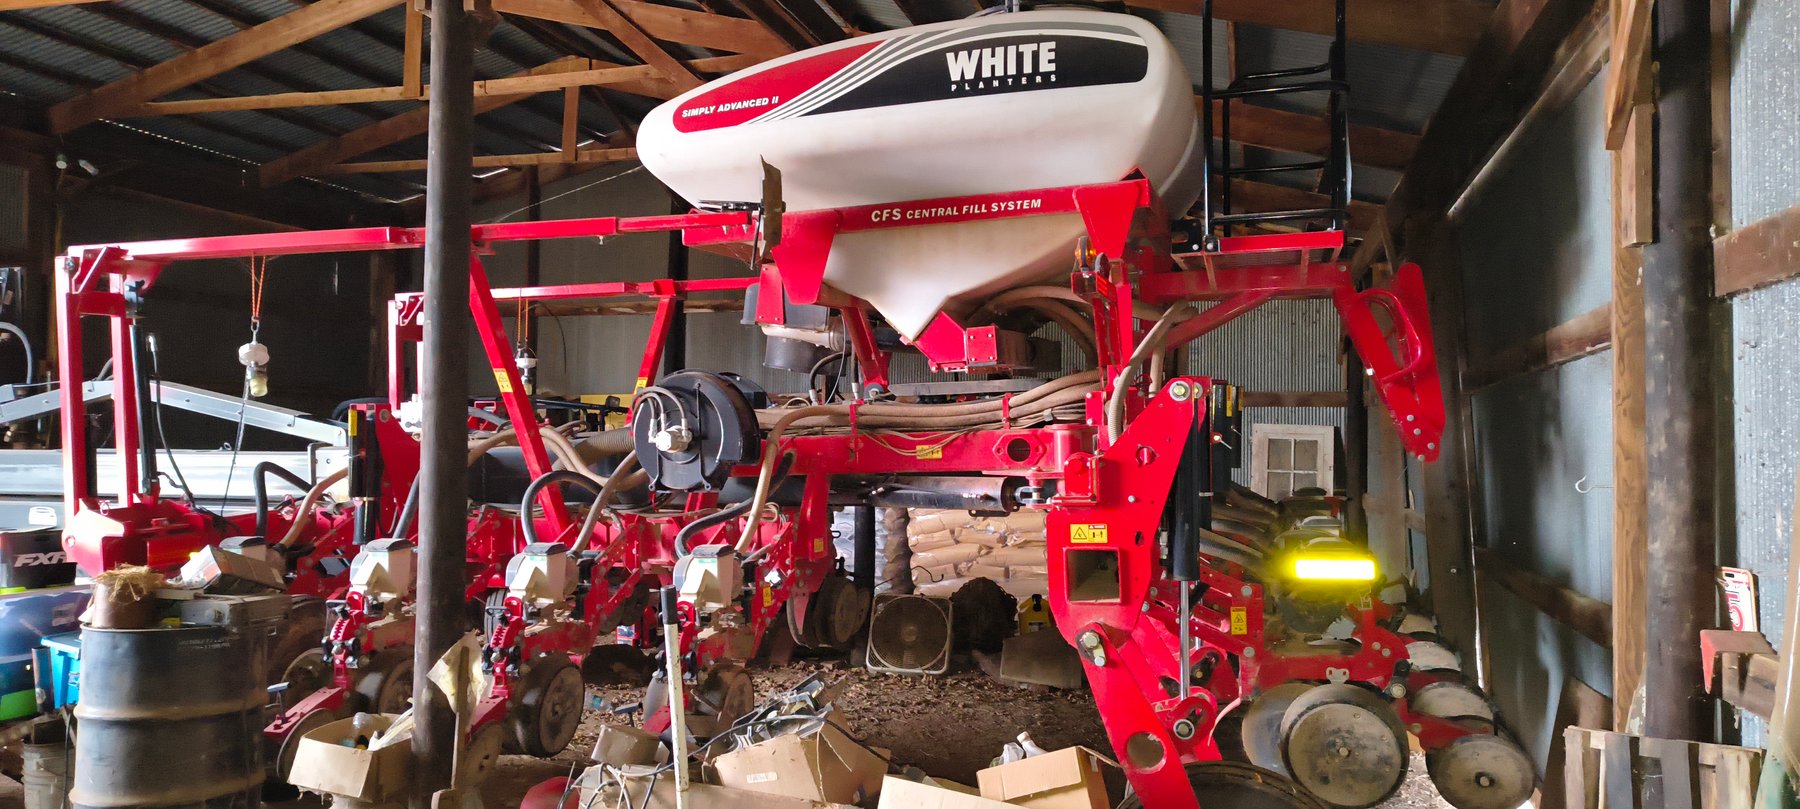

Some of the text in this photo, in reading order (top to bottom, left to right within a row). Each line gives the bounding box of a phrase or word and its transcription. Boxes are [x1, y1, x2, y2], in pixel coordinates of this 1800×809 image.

[945, 41, 1056, 82] WHITE
[951, 74, 1057, 92] PLANTERS
[681, 105, 716, 118] SIMPLY
[717, 97, 769, 113] ADVANCED
[871, 198, 1042, 222] CFS CENTRAL FILL SYSTEM
